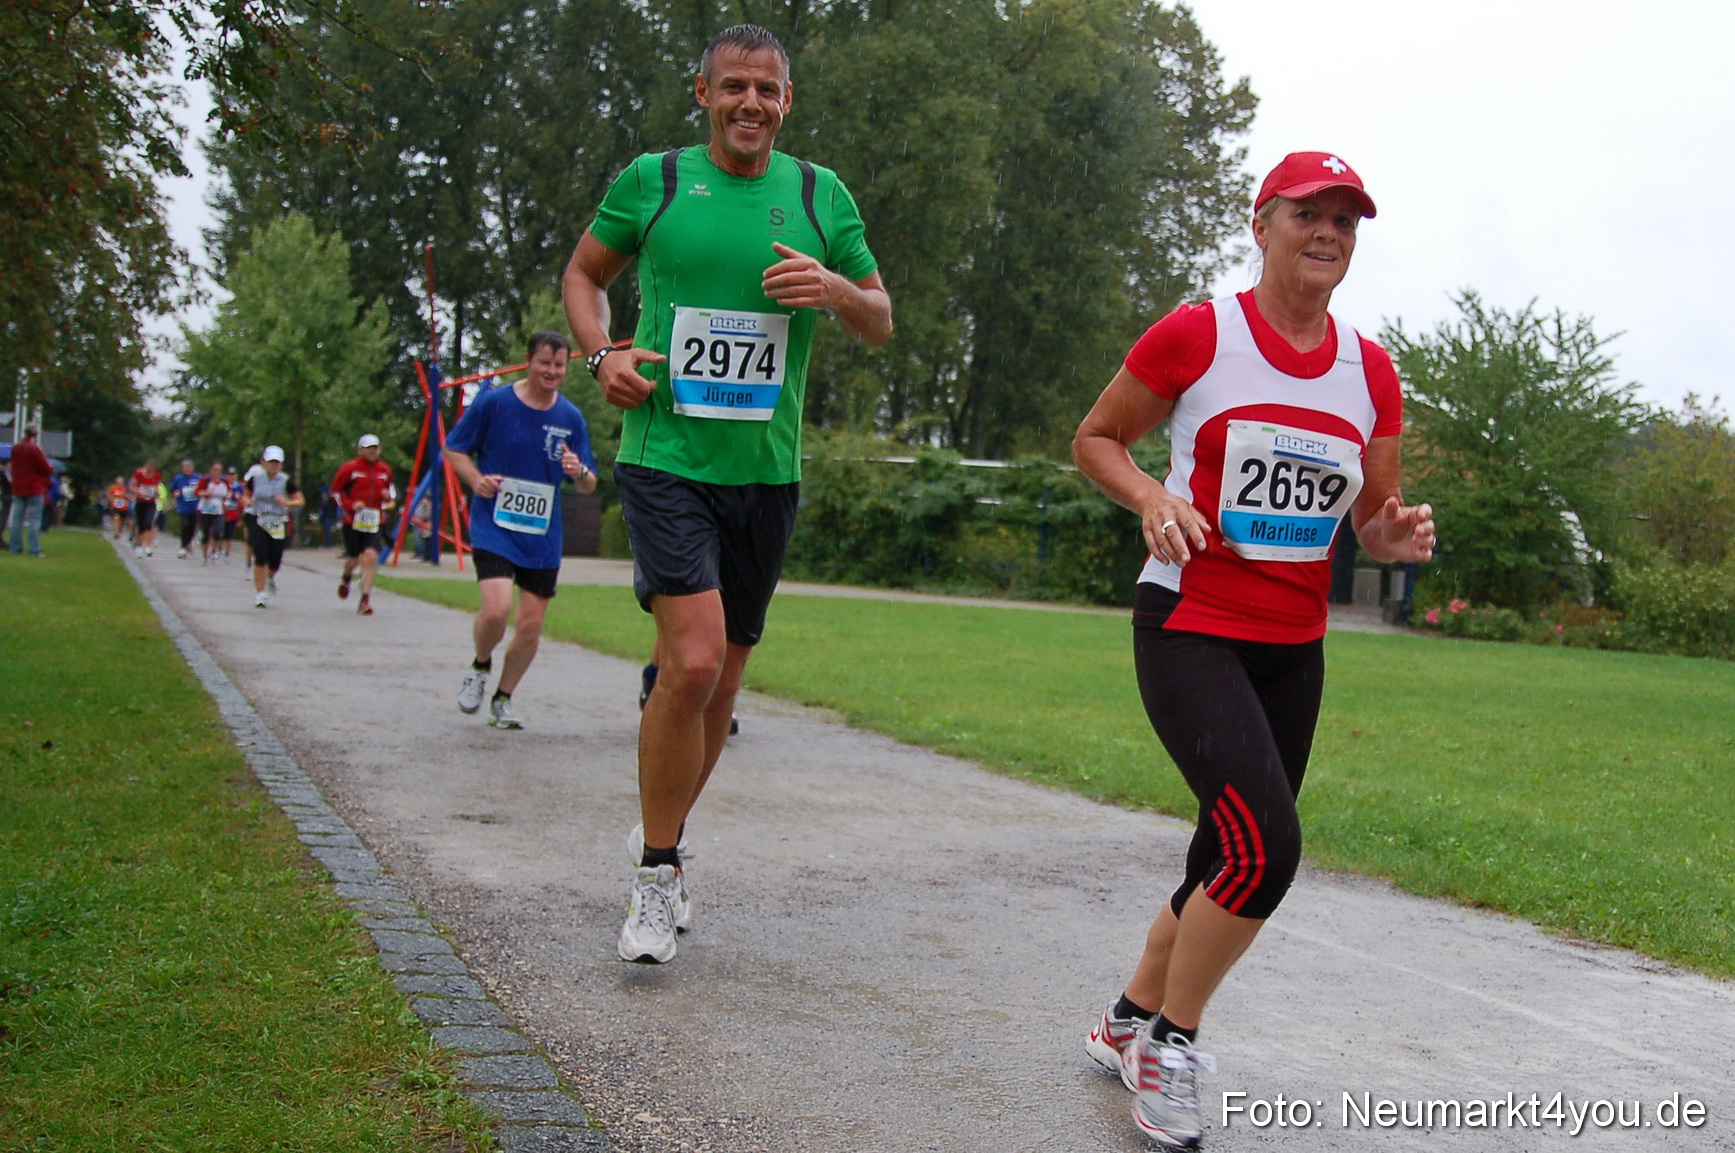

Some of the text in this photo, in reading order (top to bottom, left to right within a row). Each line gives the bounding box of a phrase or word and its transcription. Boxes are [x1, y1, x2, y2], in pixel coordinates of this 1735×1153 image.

[682, 337, 776, 380] 2974
[702, 386, 753, 408] Jürgen
[1275, 434, 1328, 455] BOCK
[1236, 457, 1348, 512] 2659
[502, 491, 548, 517] 2980
[1250, 520, 1318, 543] Marliese
